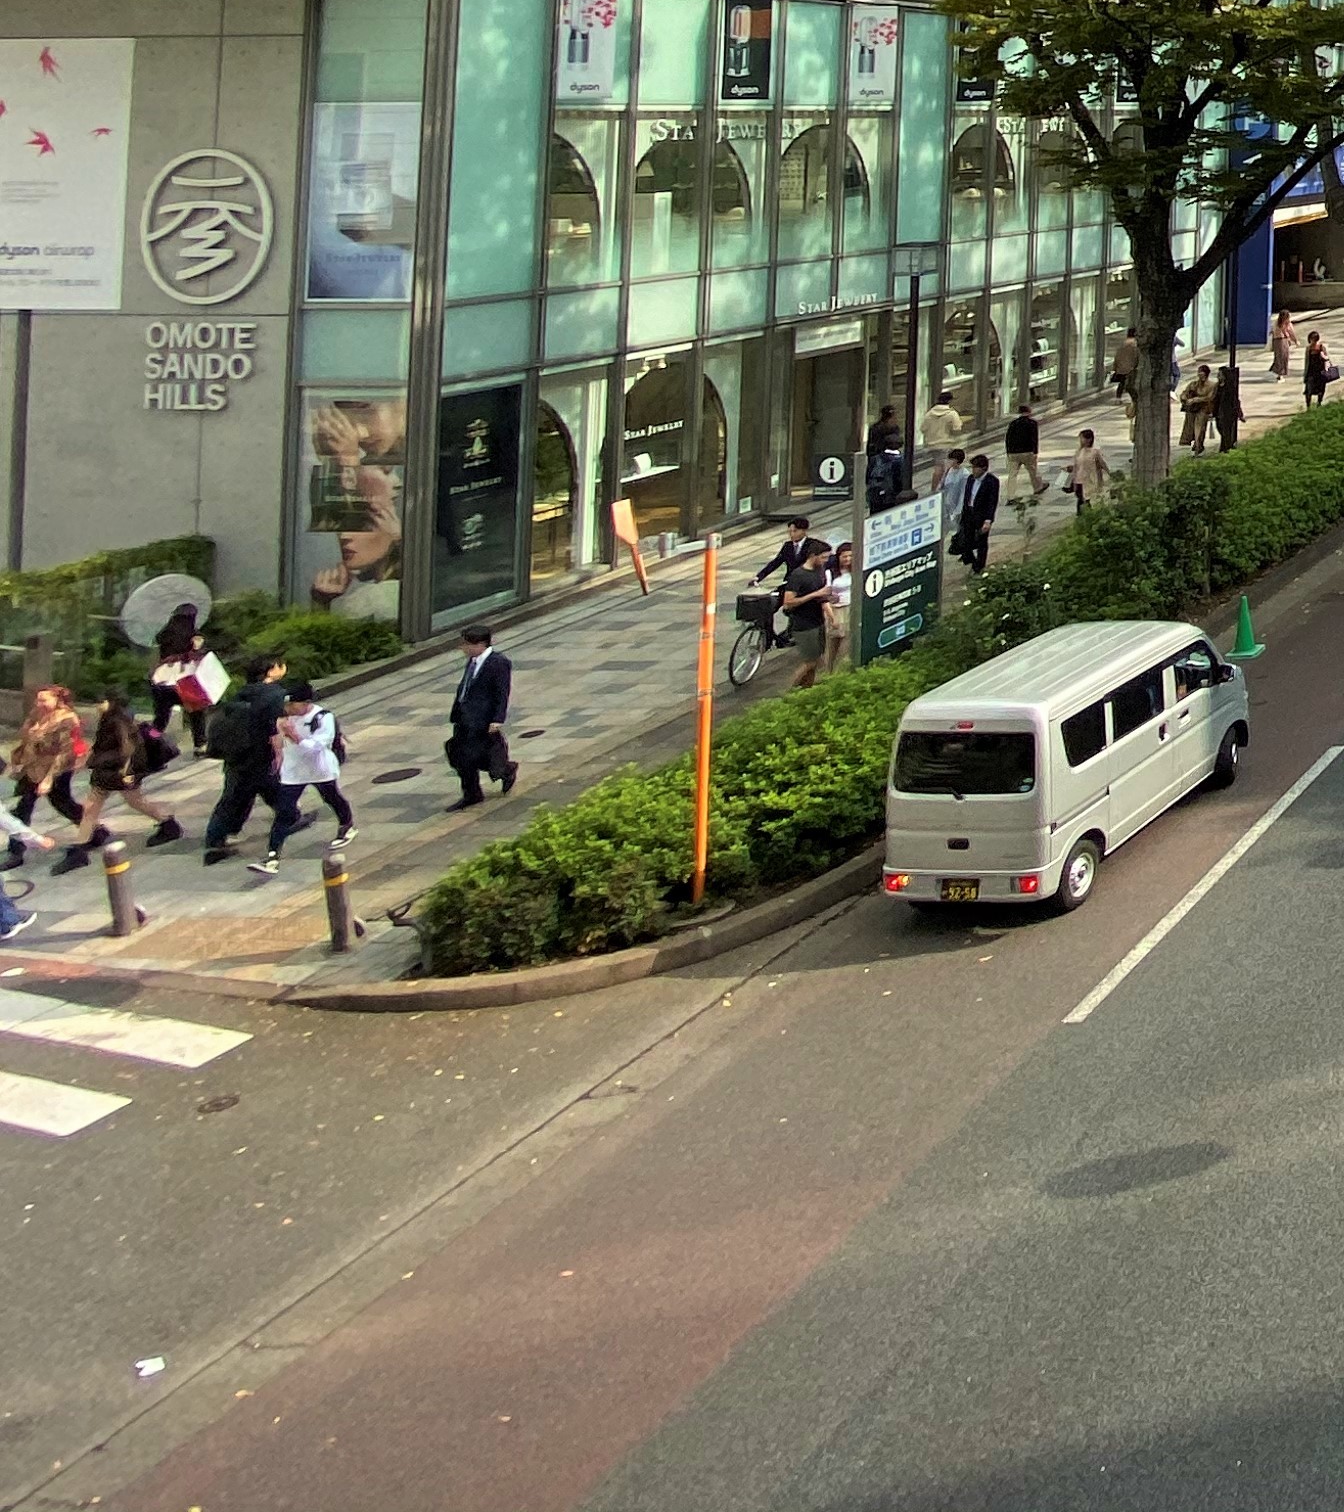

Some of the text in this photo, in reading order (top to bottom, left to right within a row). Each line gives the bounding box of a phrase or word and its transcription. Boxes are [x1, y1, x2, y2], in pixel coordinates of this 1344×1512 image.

[569, 82, 600, 94] dyson
[731, 83, 760, 96] dyson
[859, 88, 884, 97] dyson
[963, 89, 987, 98] dyson
[654, 117, 802, 143] STA JEWERY
[798, 301, 827, 315] STAR
[146, 321, 257, 349] OMOTE
[144, 352, 252, 380] SANDO
[143, 383, 228, 411] HILLS
